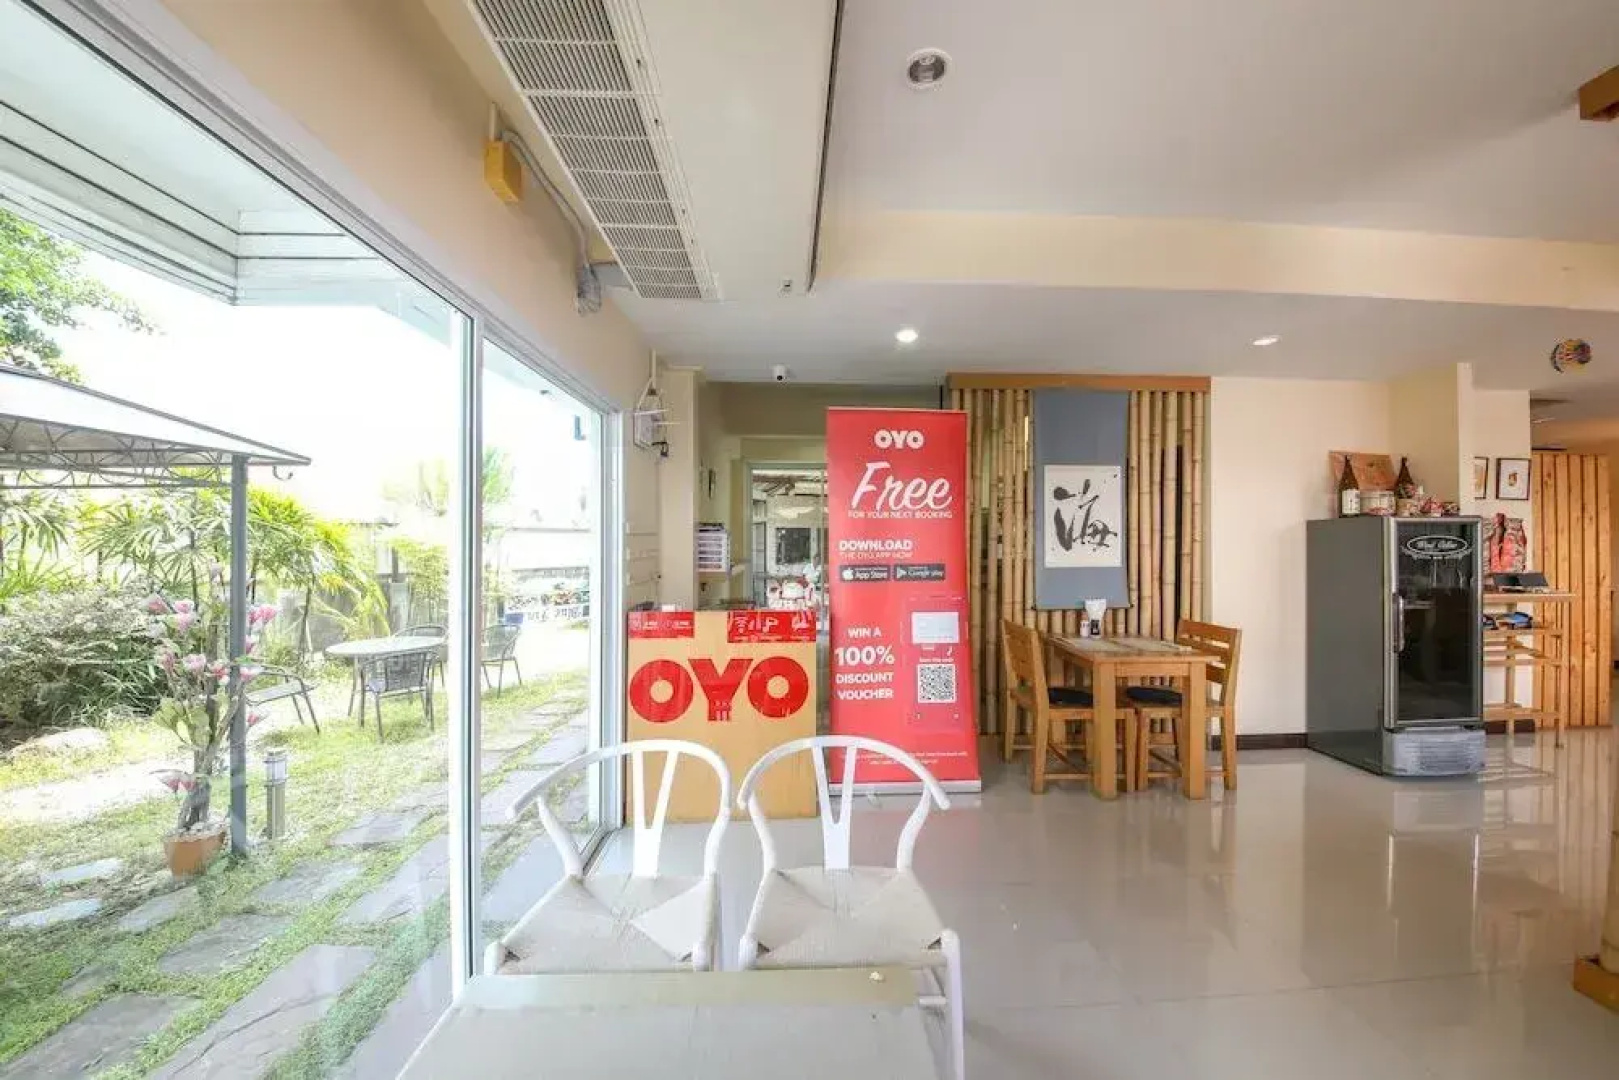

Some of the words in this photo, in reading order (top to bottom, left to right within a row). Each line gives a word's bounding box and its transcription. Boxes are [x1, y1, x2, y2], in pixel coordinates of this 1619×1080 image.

[874, 429, 924, 449] OYO
[851, 461, 952, 511] Free
[867, 511, 889, 519] YOUR
[890, 511, 912, 519] NEXT
[915, 511, 952, 519] BOOKING
[839, 540, 913, 550] DOWNLOAD
[848, 627, 872, 638] WIN
[873, 627, 882, 637] A
[835, 645, 895, 666] 100%
[836, 672, 895, 684] DISCOUNT
[629, 656, 809, 723] OYO
[837, 688, 894, 700] VOUCHER
